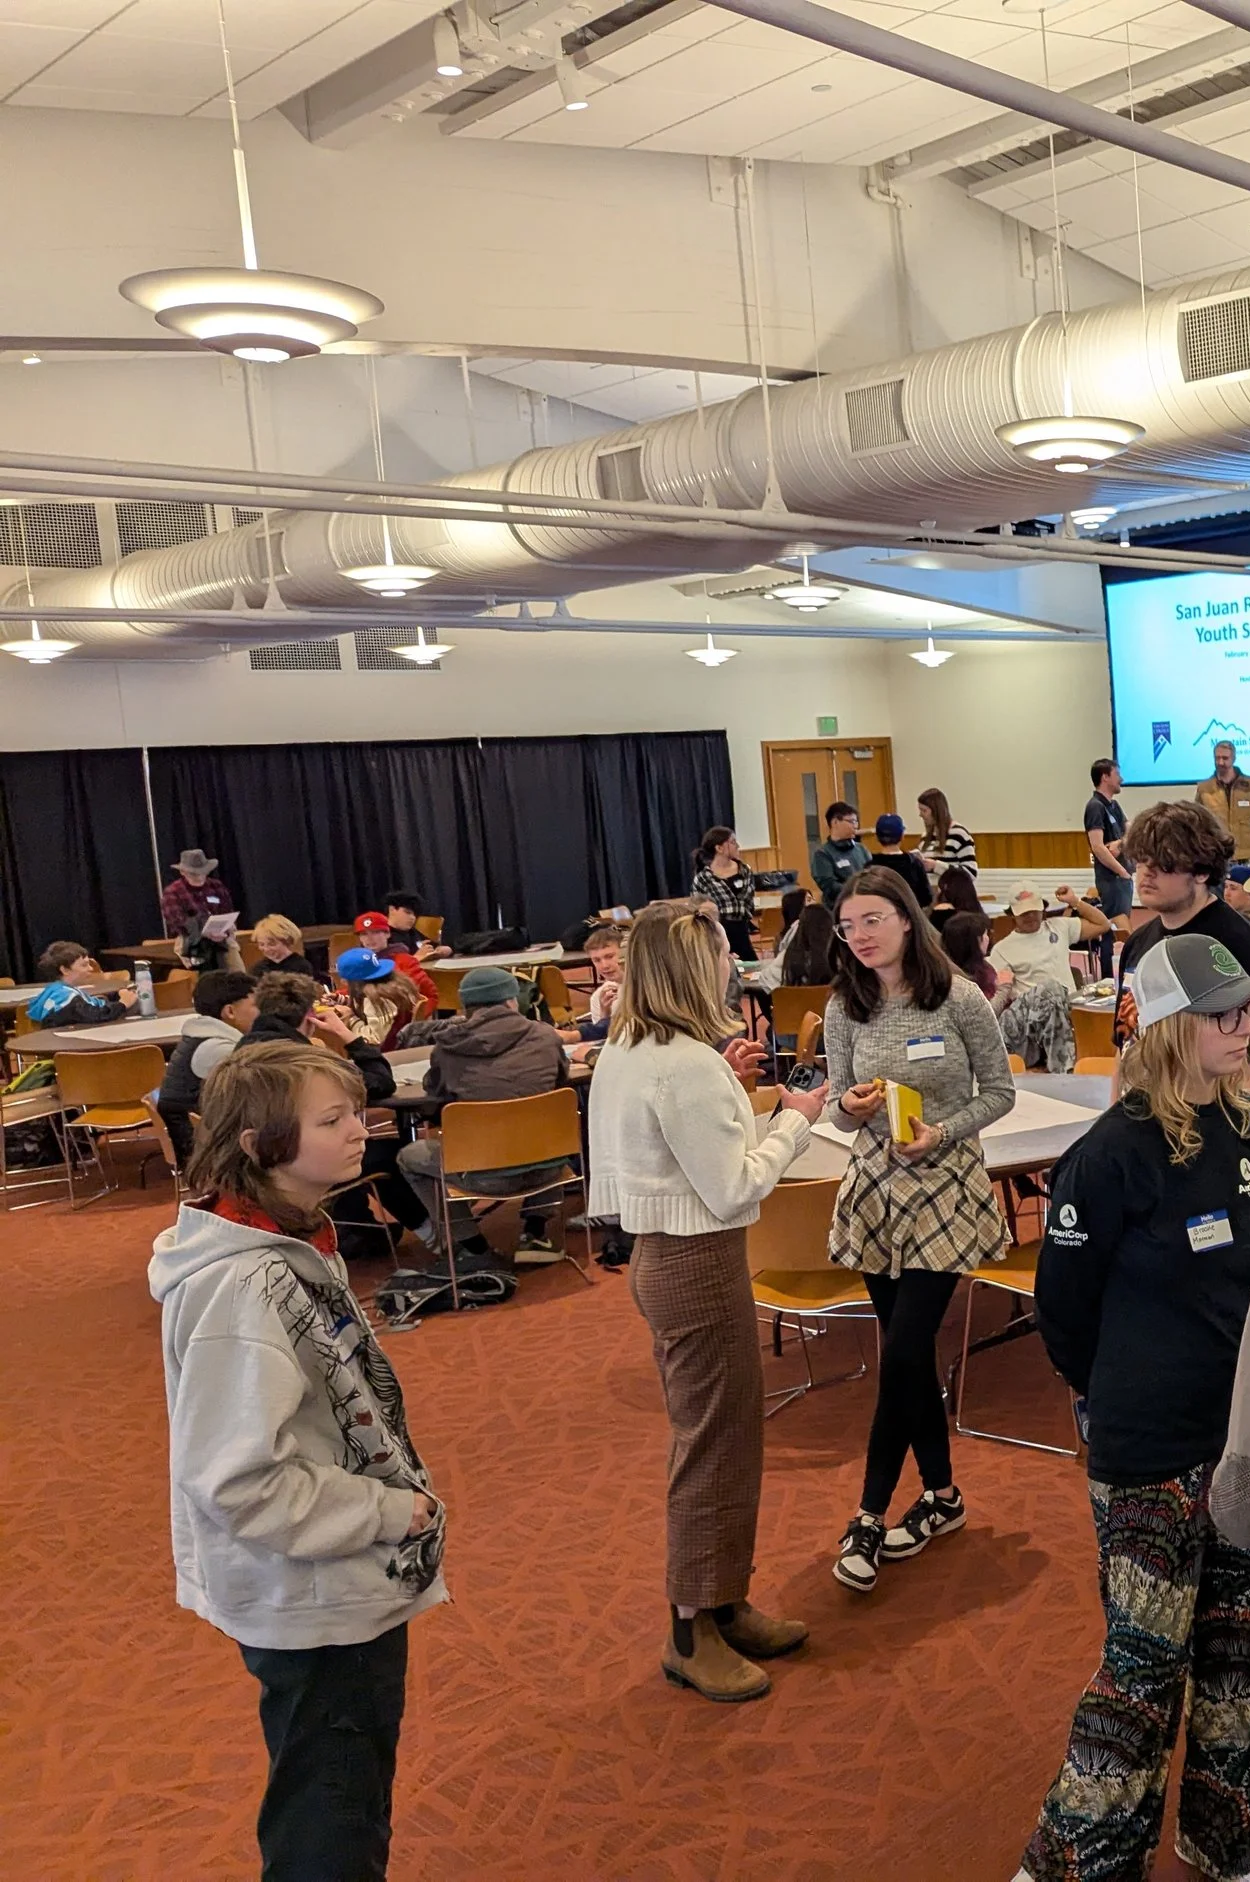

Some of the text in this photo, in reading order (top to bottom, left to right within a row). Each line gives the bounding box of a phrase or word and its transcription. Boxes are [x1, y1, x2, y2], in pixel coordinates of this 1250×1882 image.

[1176, 604, 1201, 620] San
[1205, 601, 1239, 617] Juan
[1196, 622, 1238, 643] Youth
[1210, 738, 1246, 748] Mtain
[1054, 1237, 1082, 1246] Colorado
